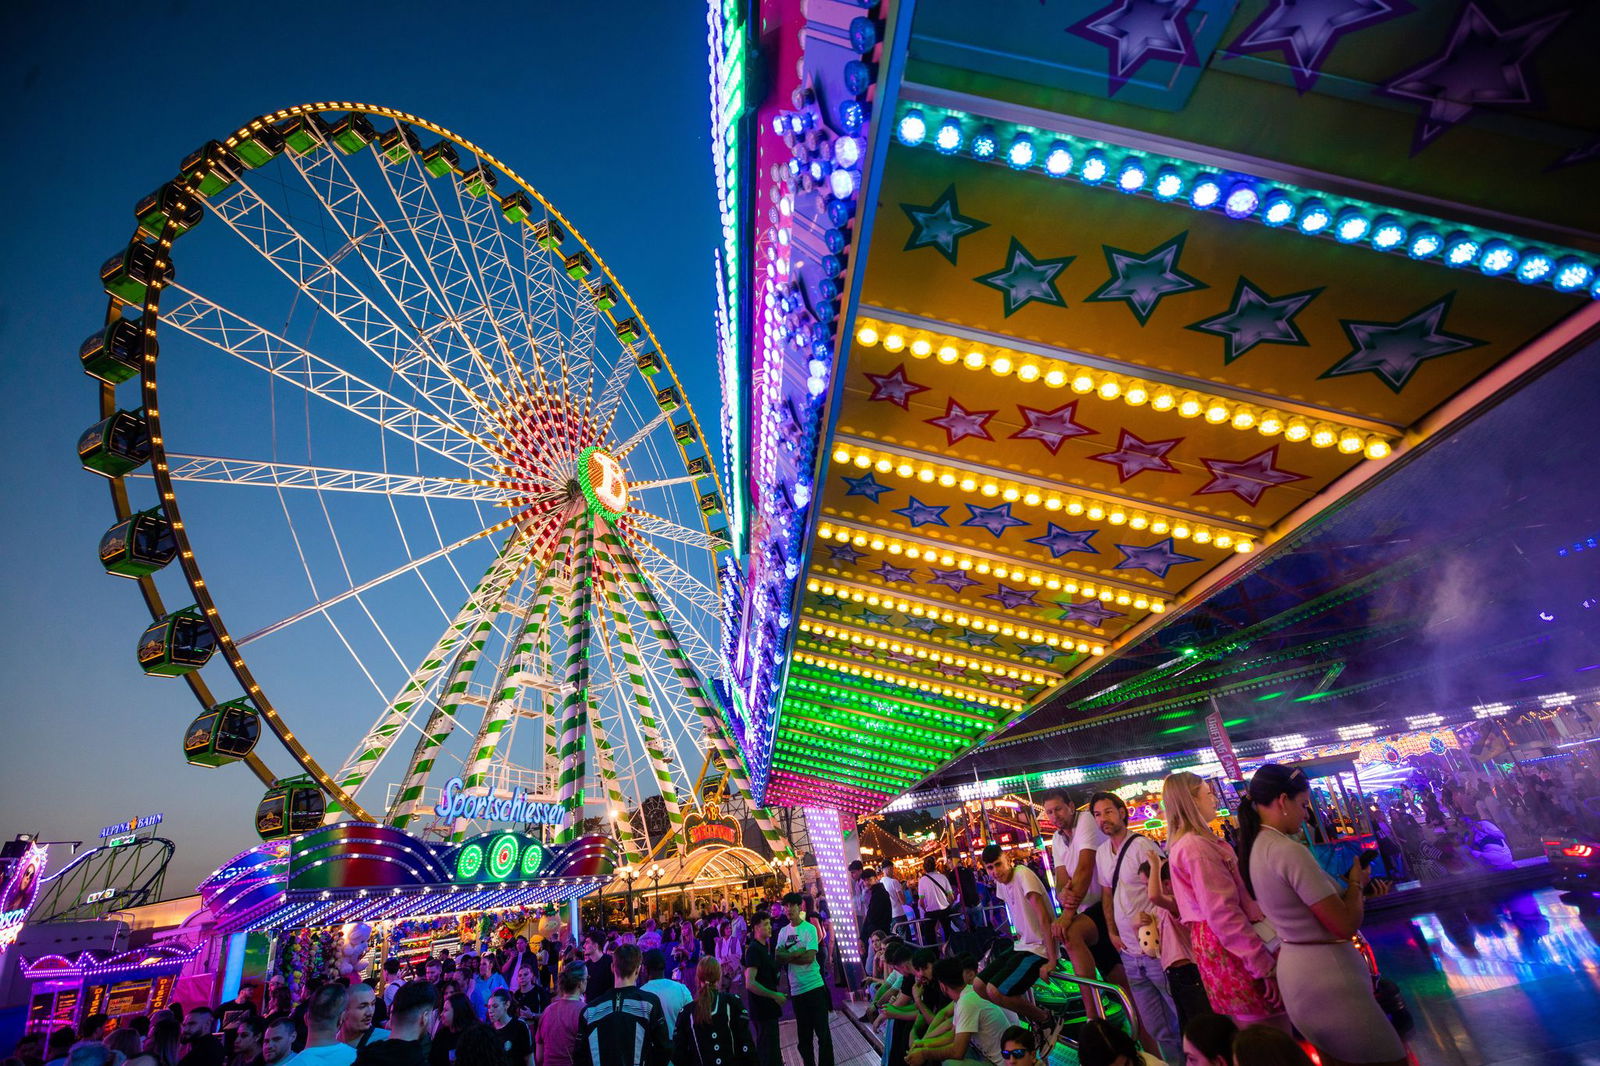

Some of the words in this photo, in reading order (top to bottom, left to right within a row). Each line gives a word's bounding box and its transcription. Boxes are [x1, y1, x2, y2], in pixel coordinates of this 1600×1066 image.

[1208, 718, 1228, 753] DRIFTING
[434, 776, 566, 825] Sportschiessen
[99, 821, 131, 838] ALPINA
[137, 813, 164, 828] BAHN
